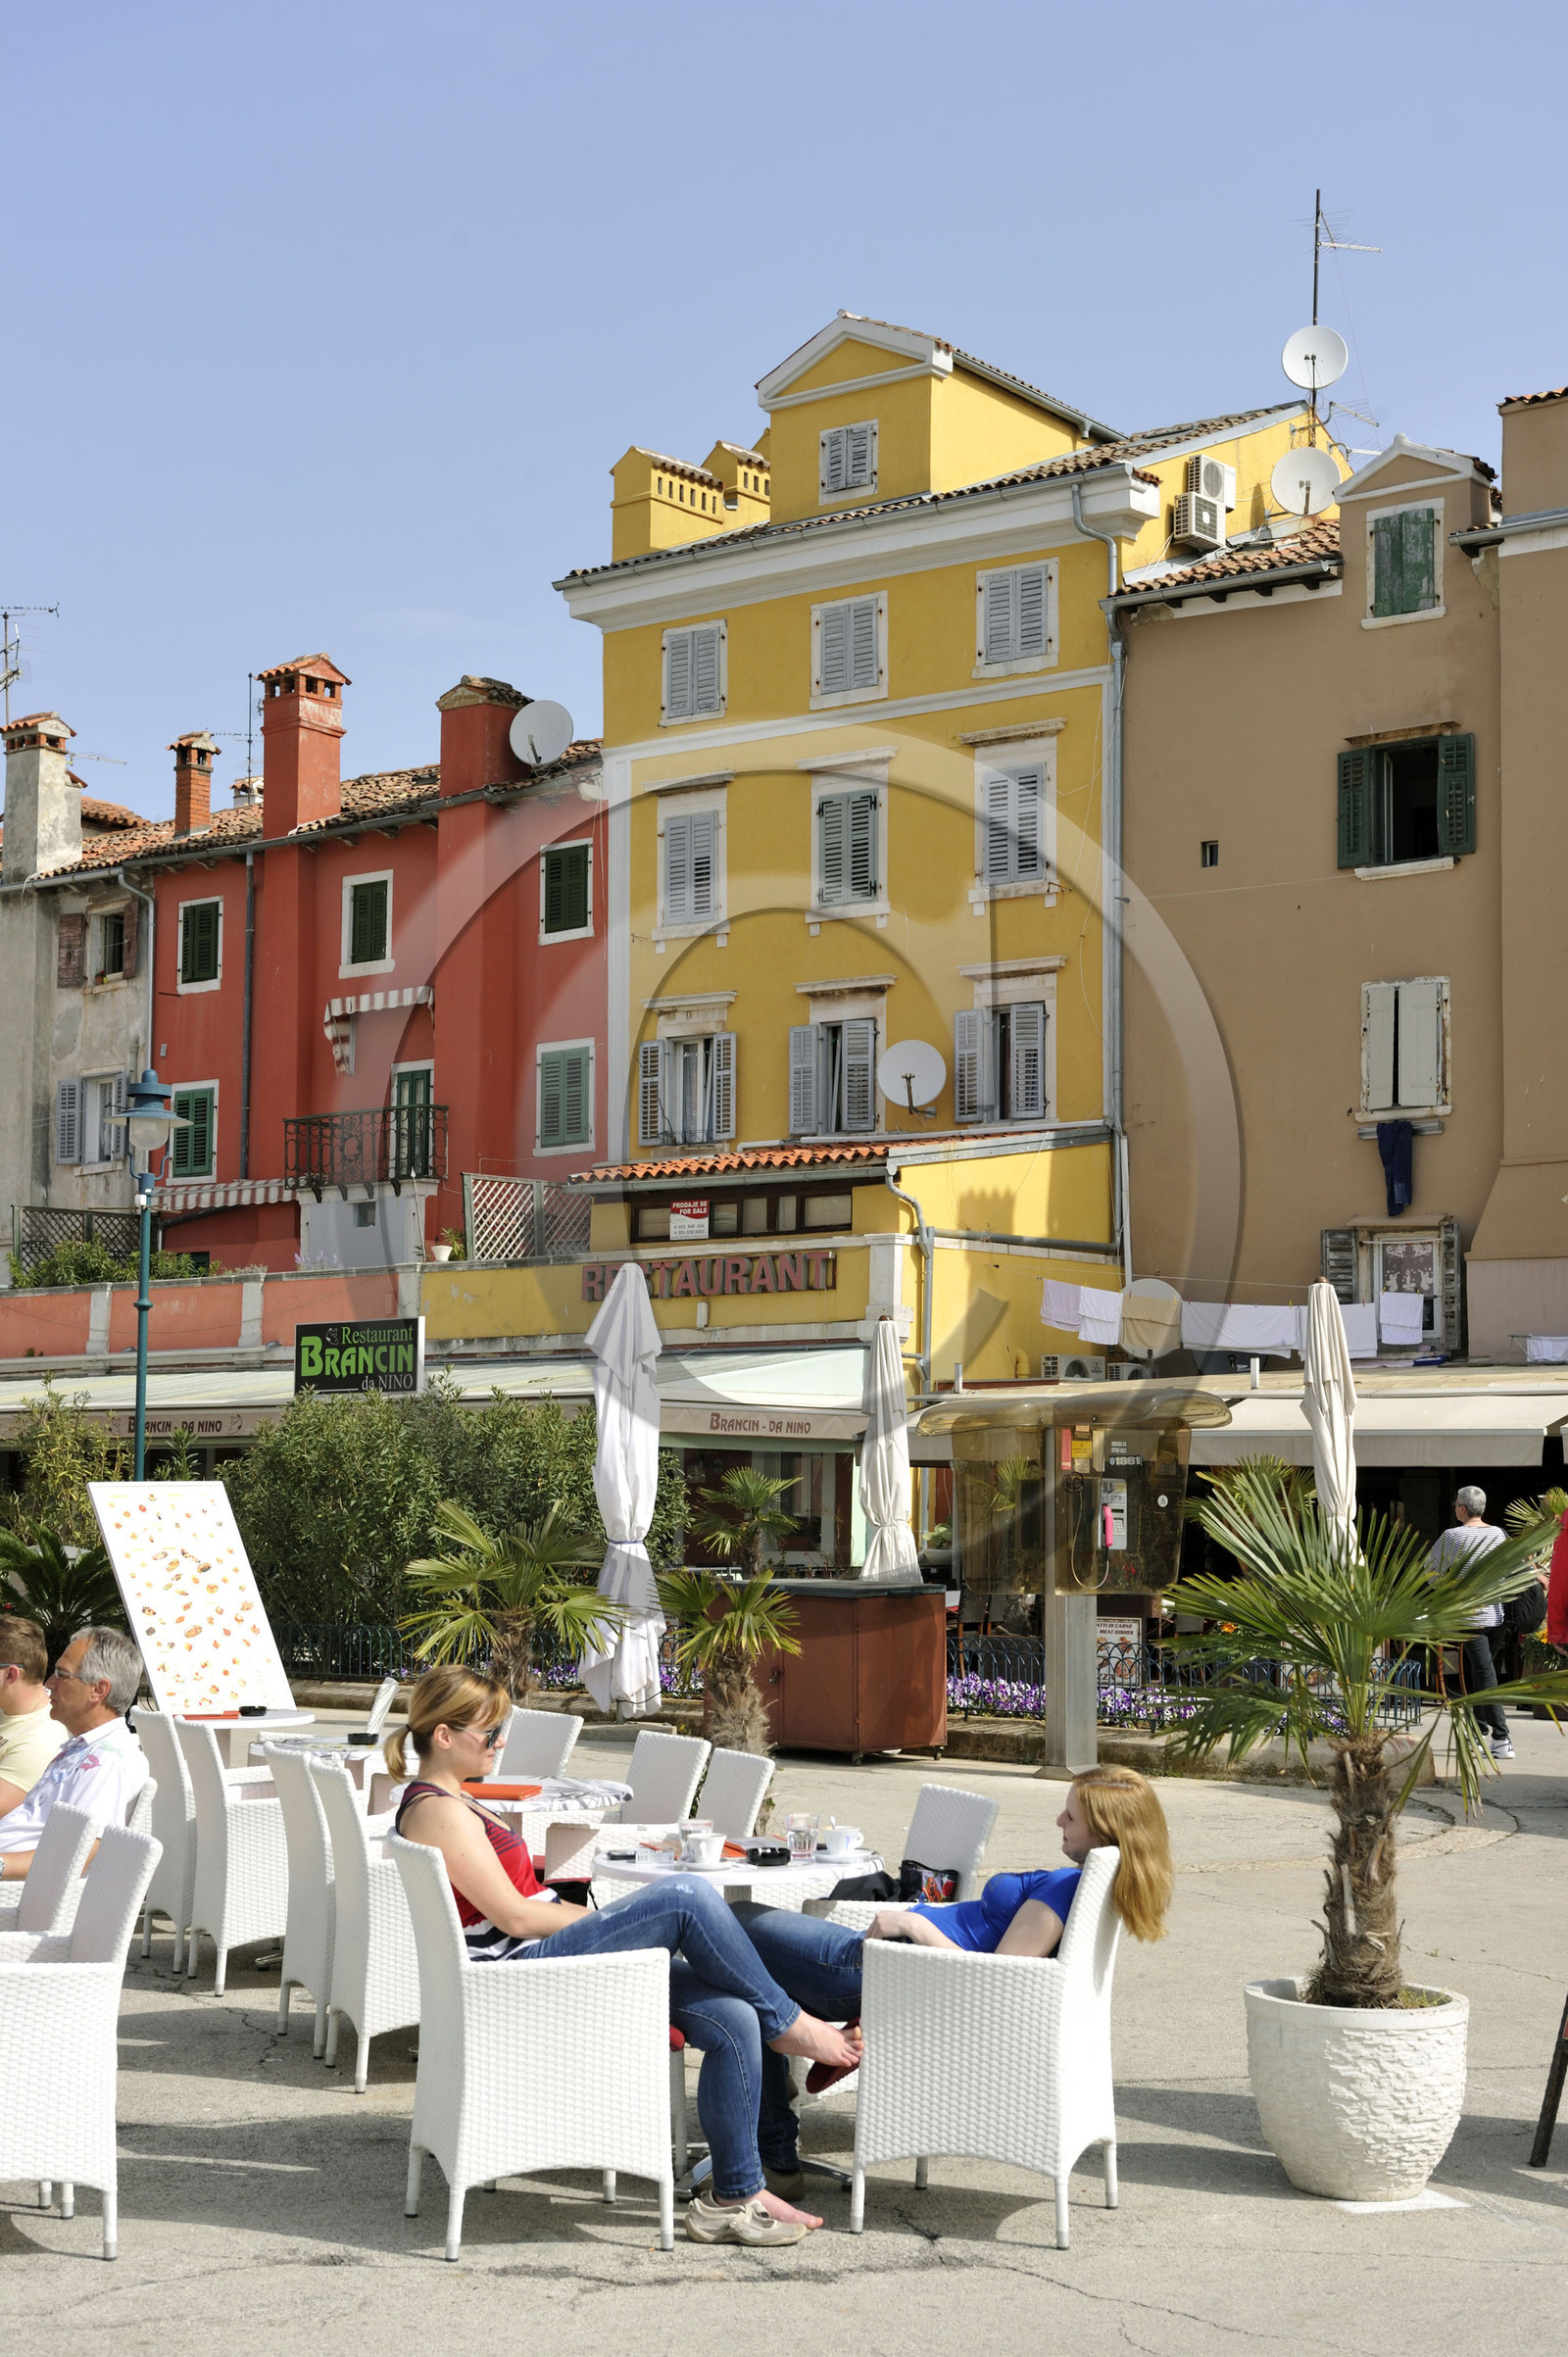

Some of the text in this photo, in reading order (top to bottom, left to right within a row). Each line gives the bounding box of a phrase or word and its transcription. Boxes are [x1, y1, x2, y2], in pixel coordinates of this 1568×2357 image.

[341, 1325, 414, 1345] Restaurant
[362, 1373, 414, 1390] da NINO
[127, 1415, 172, 1433] BANCIN
[197, 1420, 222, 1433] NINO
[710, 1412, 760, 1432] BRANCIN
[769, 1420, 783, 1434] DA
[786, 1421, 811, 1434] NINO
